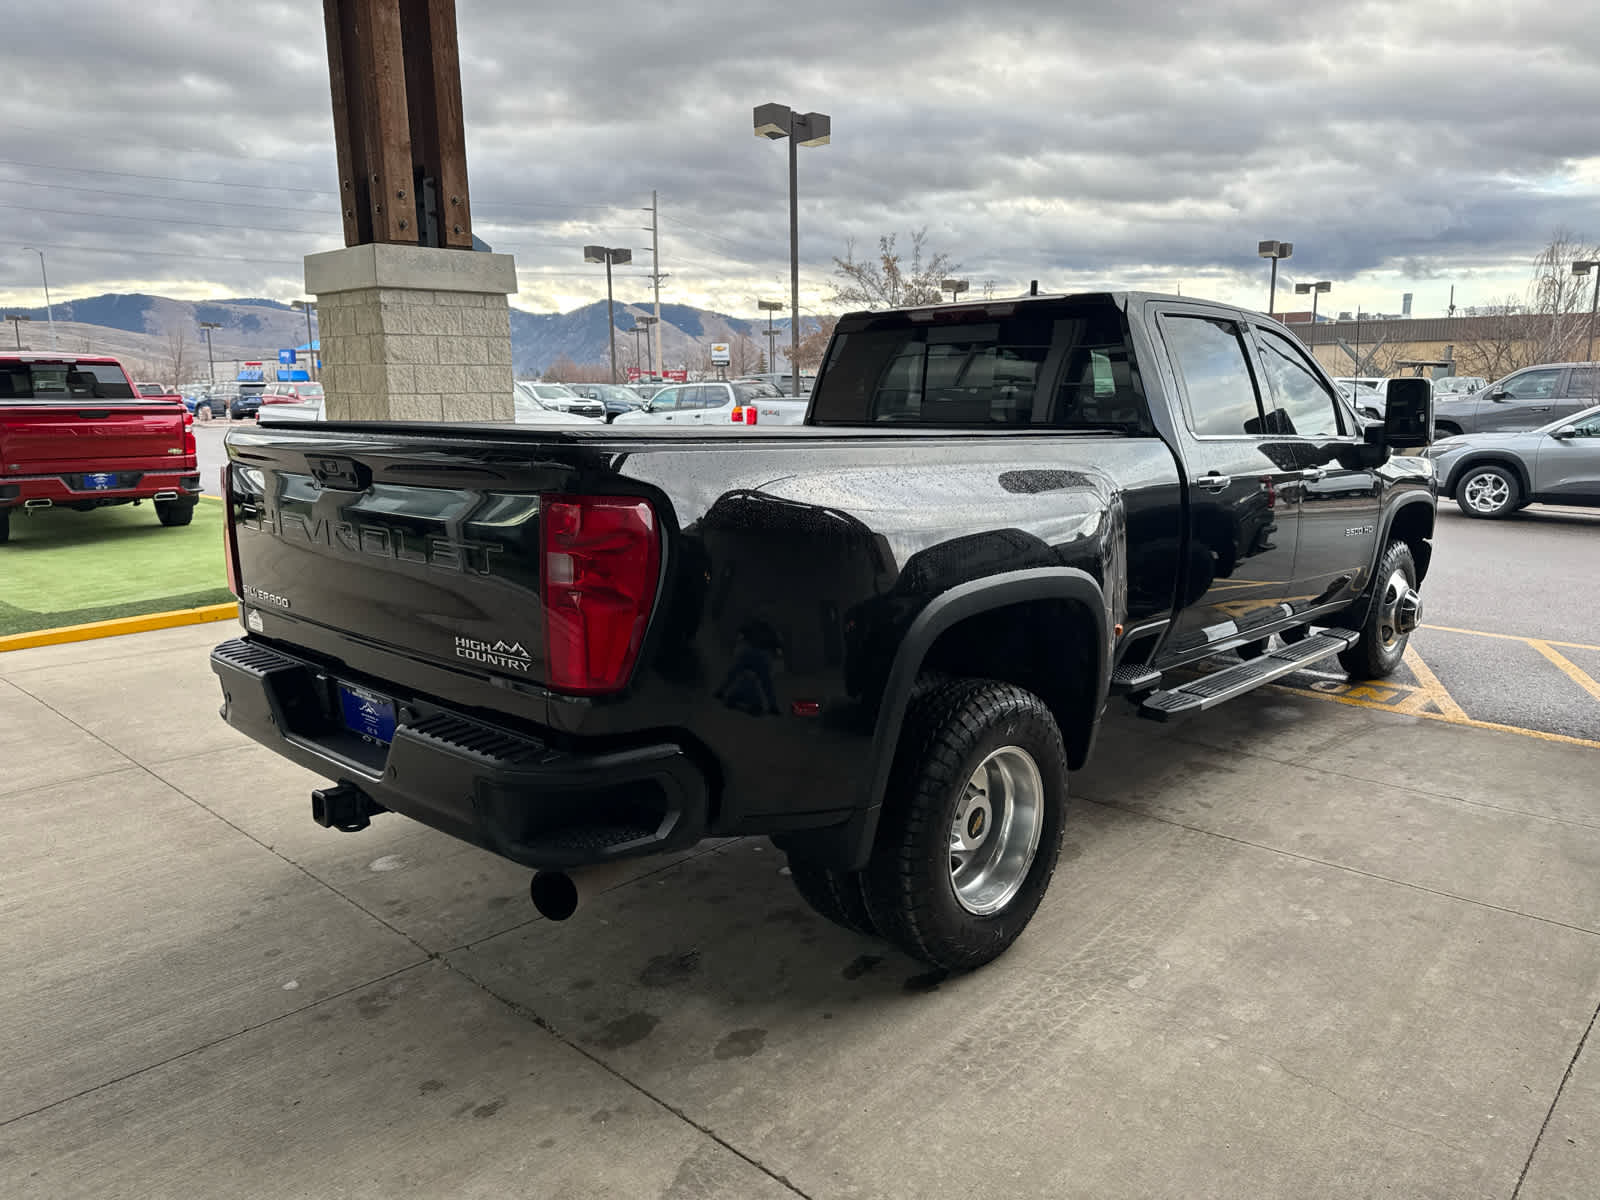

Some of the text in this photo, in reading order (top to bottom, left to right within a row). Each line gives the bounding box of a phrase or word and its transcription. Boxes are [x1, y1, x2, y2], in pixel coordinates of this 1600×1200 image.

[241, 500, 504, 577] CHEVROLET
[243, 584, 289, 608] SILVERADO
[455, 636, 491, 653] HIGH
[456, 647, 532, 672] COUNTRY
